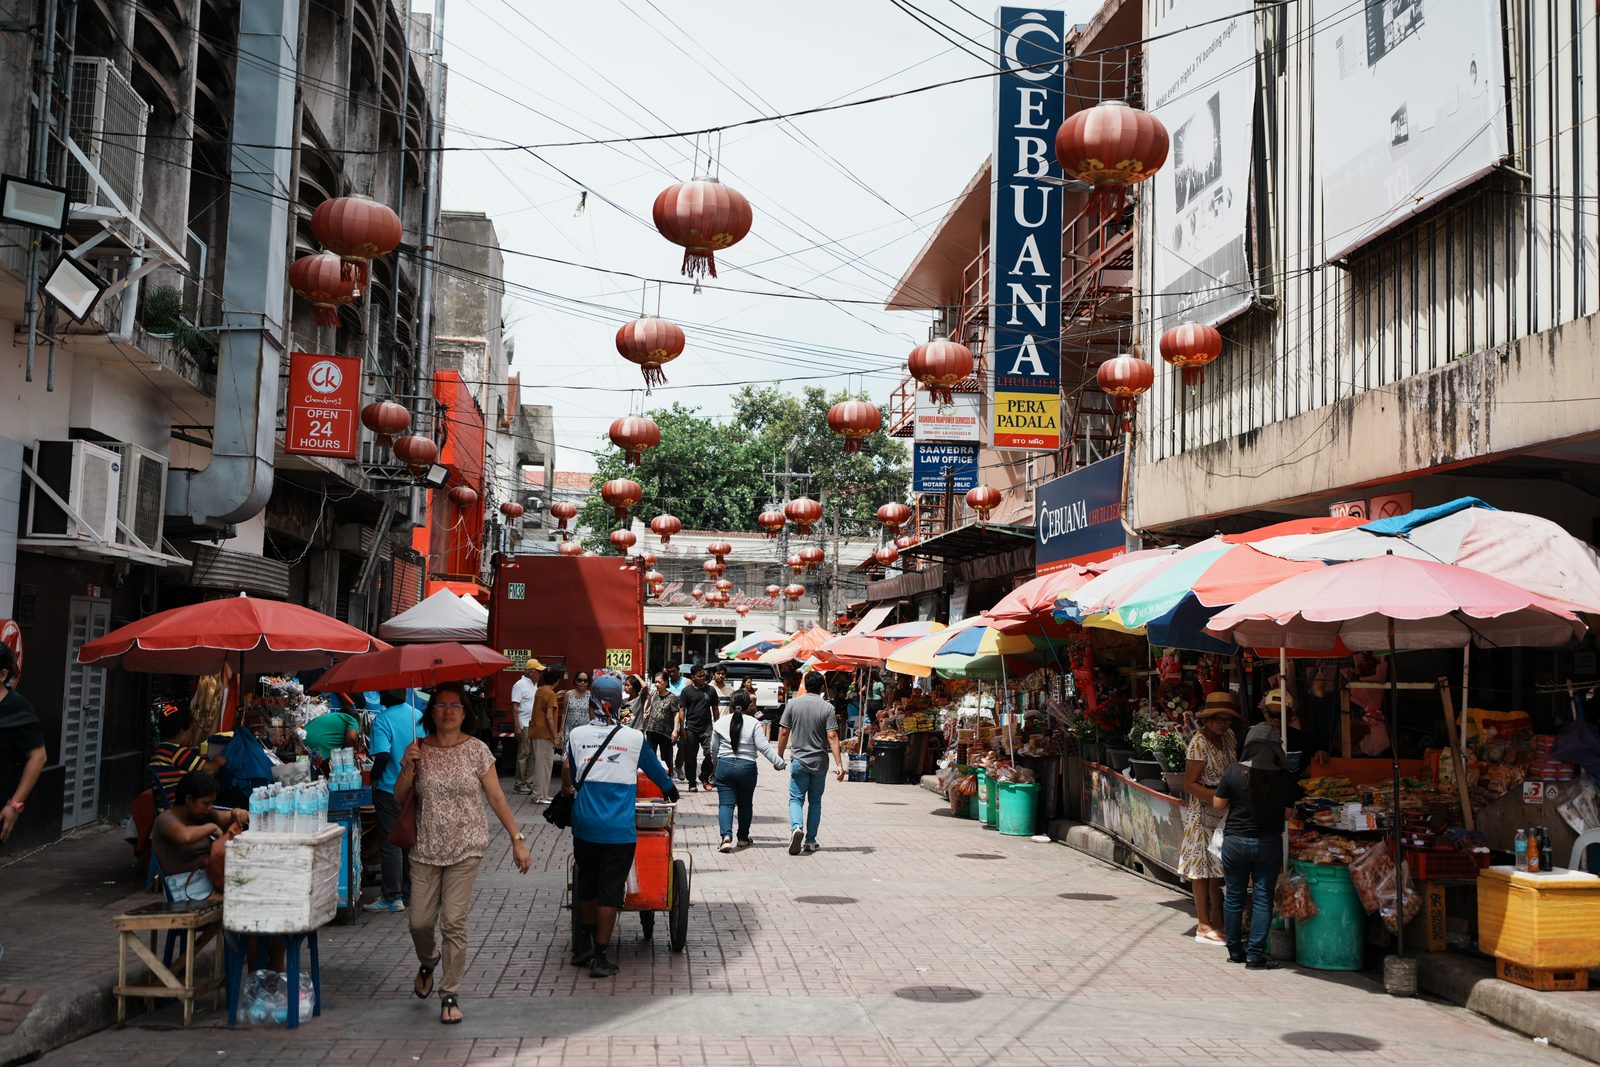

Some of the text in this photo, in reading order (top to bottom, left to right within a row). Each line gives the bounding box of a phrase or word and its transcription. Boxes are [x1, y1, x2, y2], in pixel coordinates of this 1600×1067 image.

[1155, 93, 1168, 107] Make
[1180, 65, 1192, 84] night
[1195, 53, 1203, 69] TV
[1202, 36, 1223, 62] bonding
[1222, 19, 1239, 40] night.
[1007, 399, 1047, 413] PERA
[307, 409, 338, 419] OPEN
[997, 414, 1057, 429] PADALA
[309, 421, 333, 437] 24
[300, 438, 341, 449] HOURS
[919, 446, 974, 454] SAAVEDRA
[920, 456, 973, 464] LAW OFFICE
[607, 653, 631, 666] 1342
